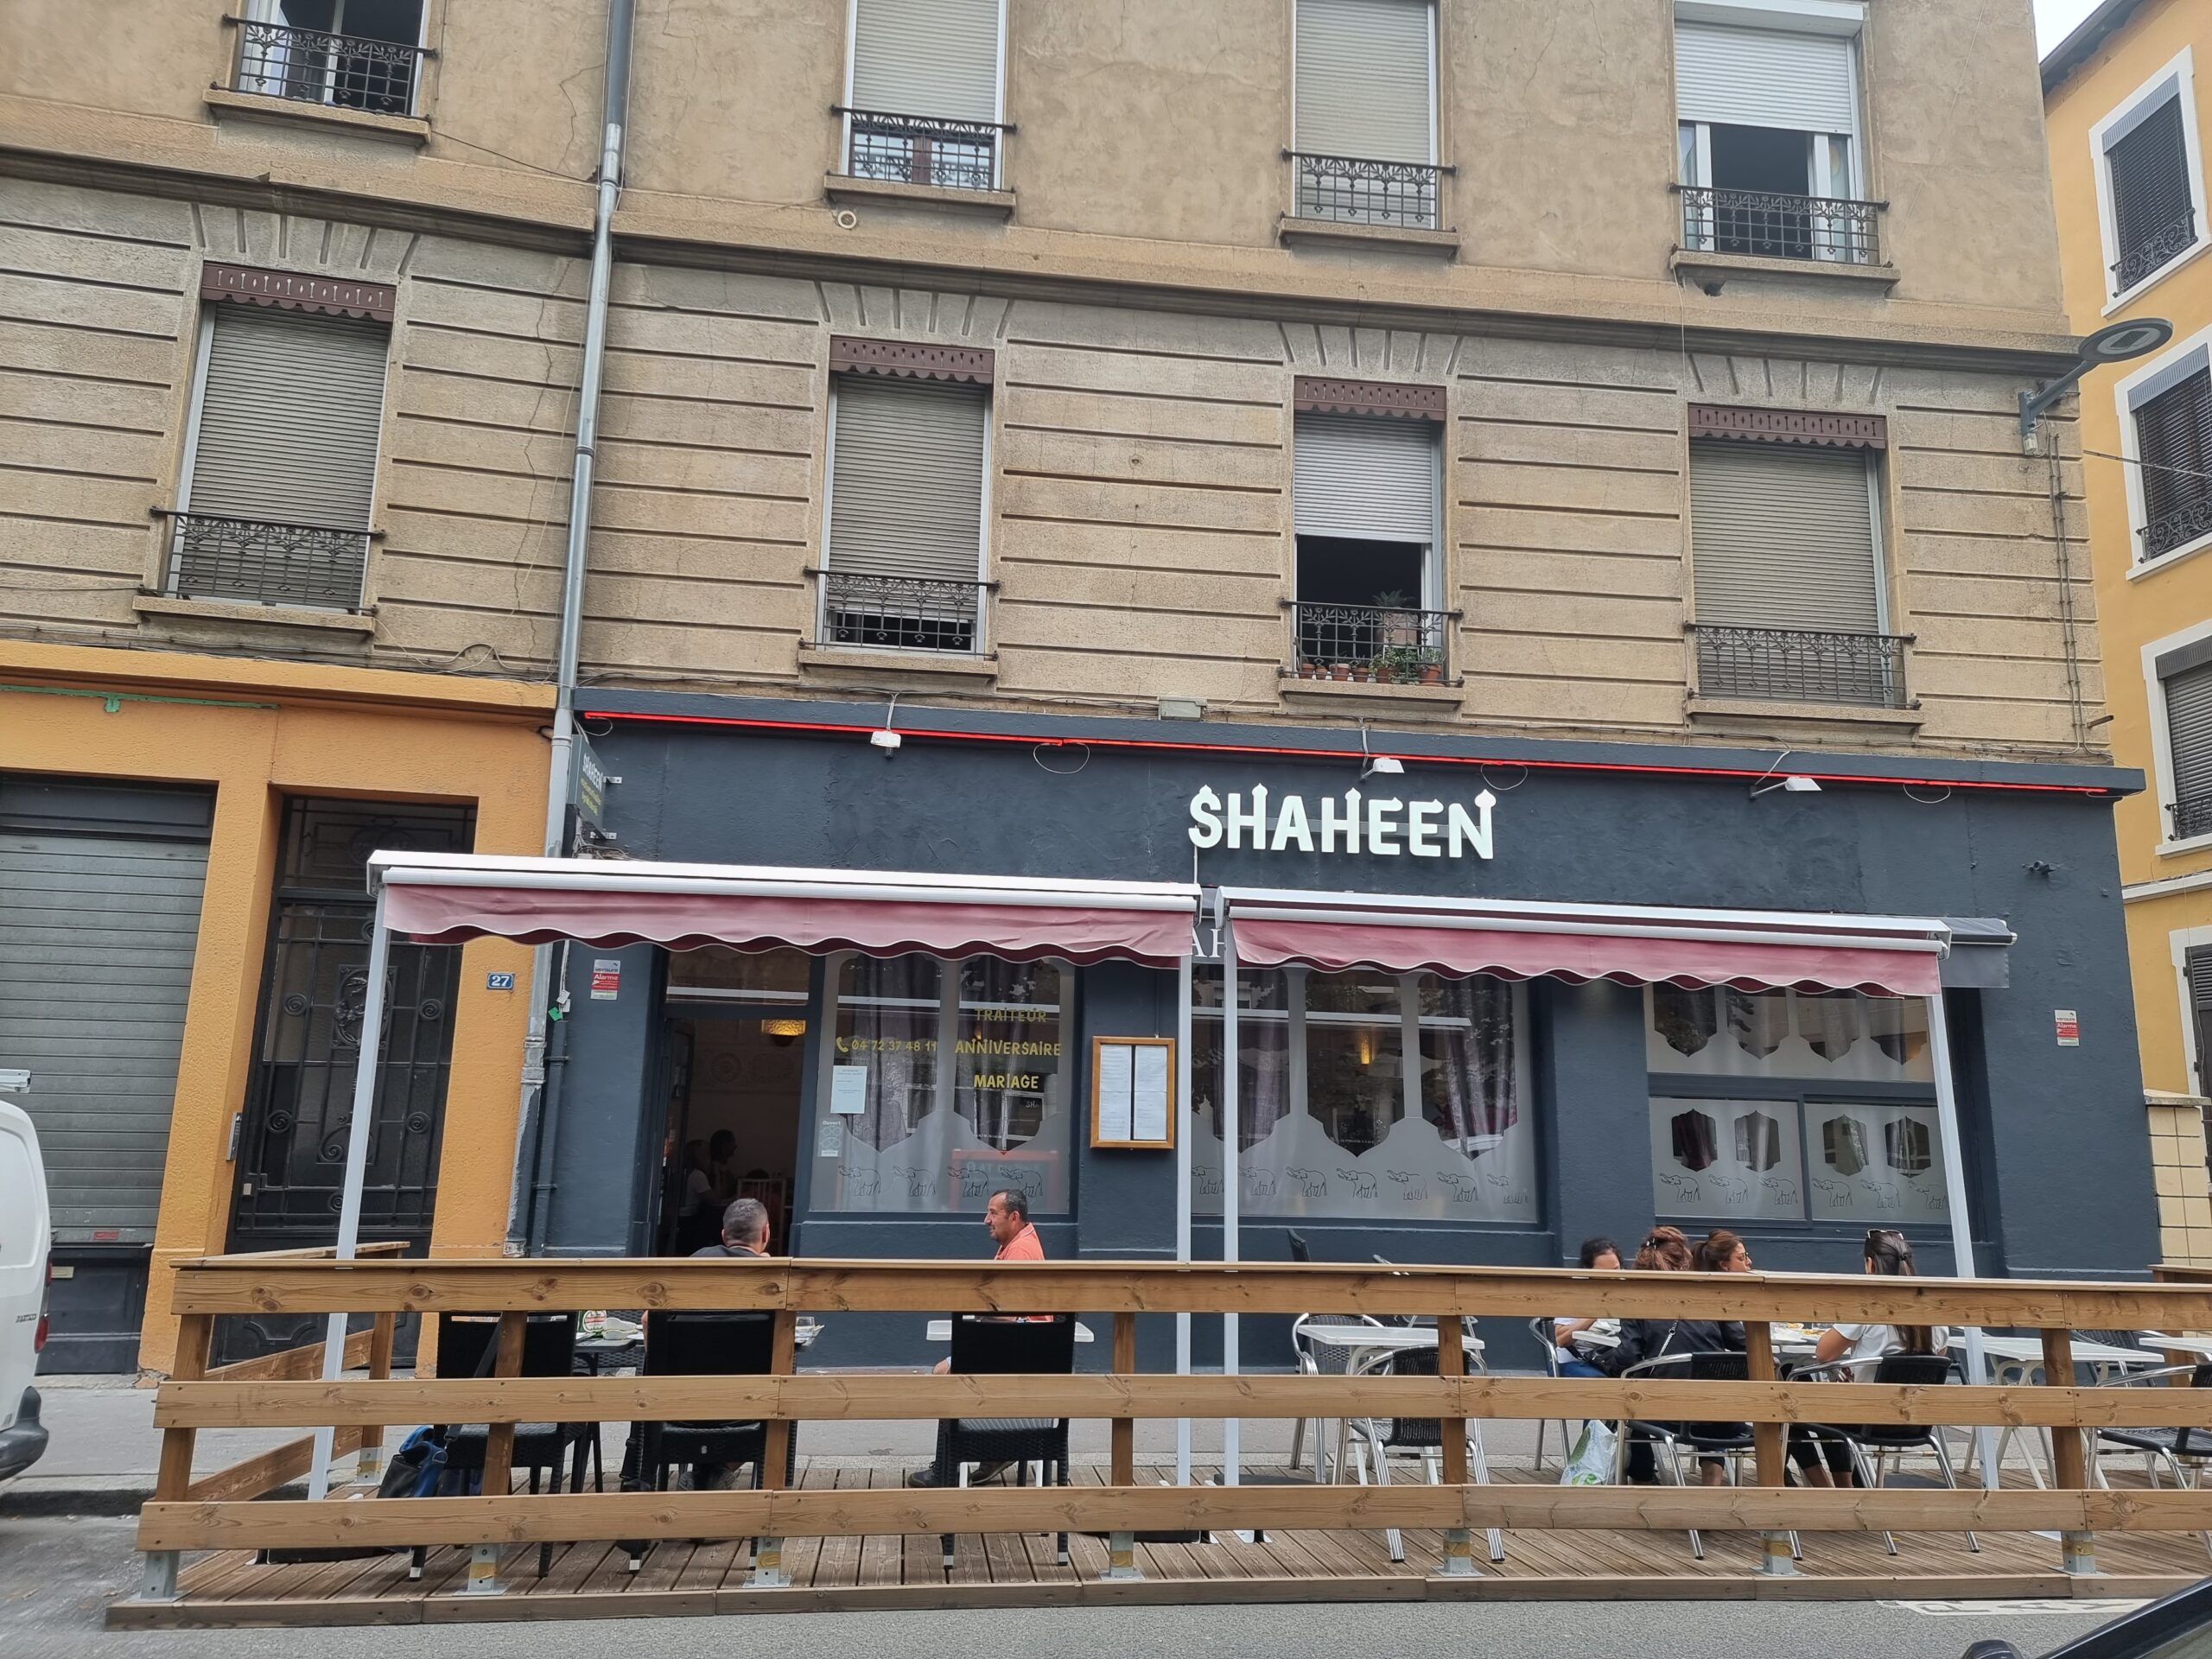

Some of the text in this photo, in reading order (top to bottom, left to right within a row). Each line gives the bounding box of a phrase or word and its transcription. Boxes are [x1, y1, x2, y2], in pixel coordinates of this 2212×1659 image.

[1188, 782, 1497, 860] SHAHEEN
[491, 975, 510, 987] 27
[974, 1007, 1047, 1022] TRAITEUR
[851, 1039, 938, 1052] 04 72 37 48 11
[955, 1039, 1062, 1056] ANNIVERSAIRE
[974, 1073, 1039, 1089] MARIAGE
